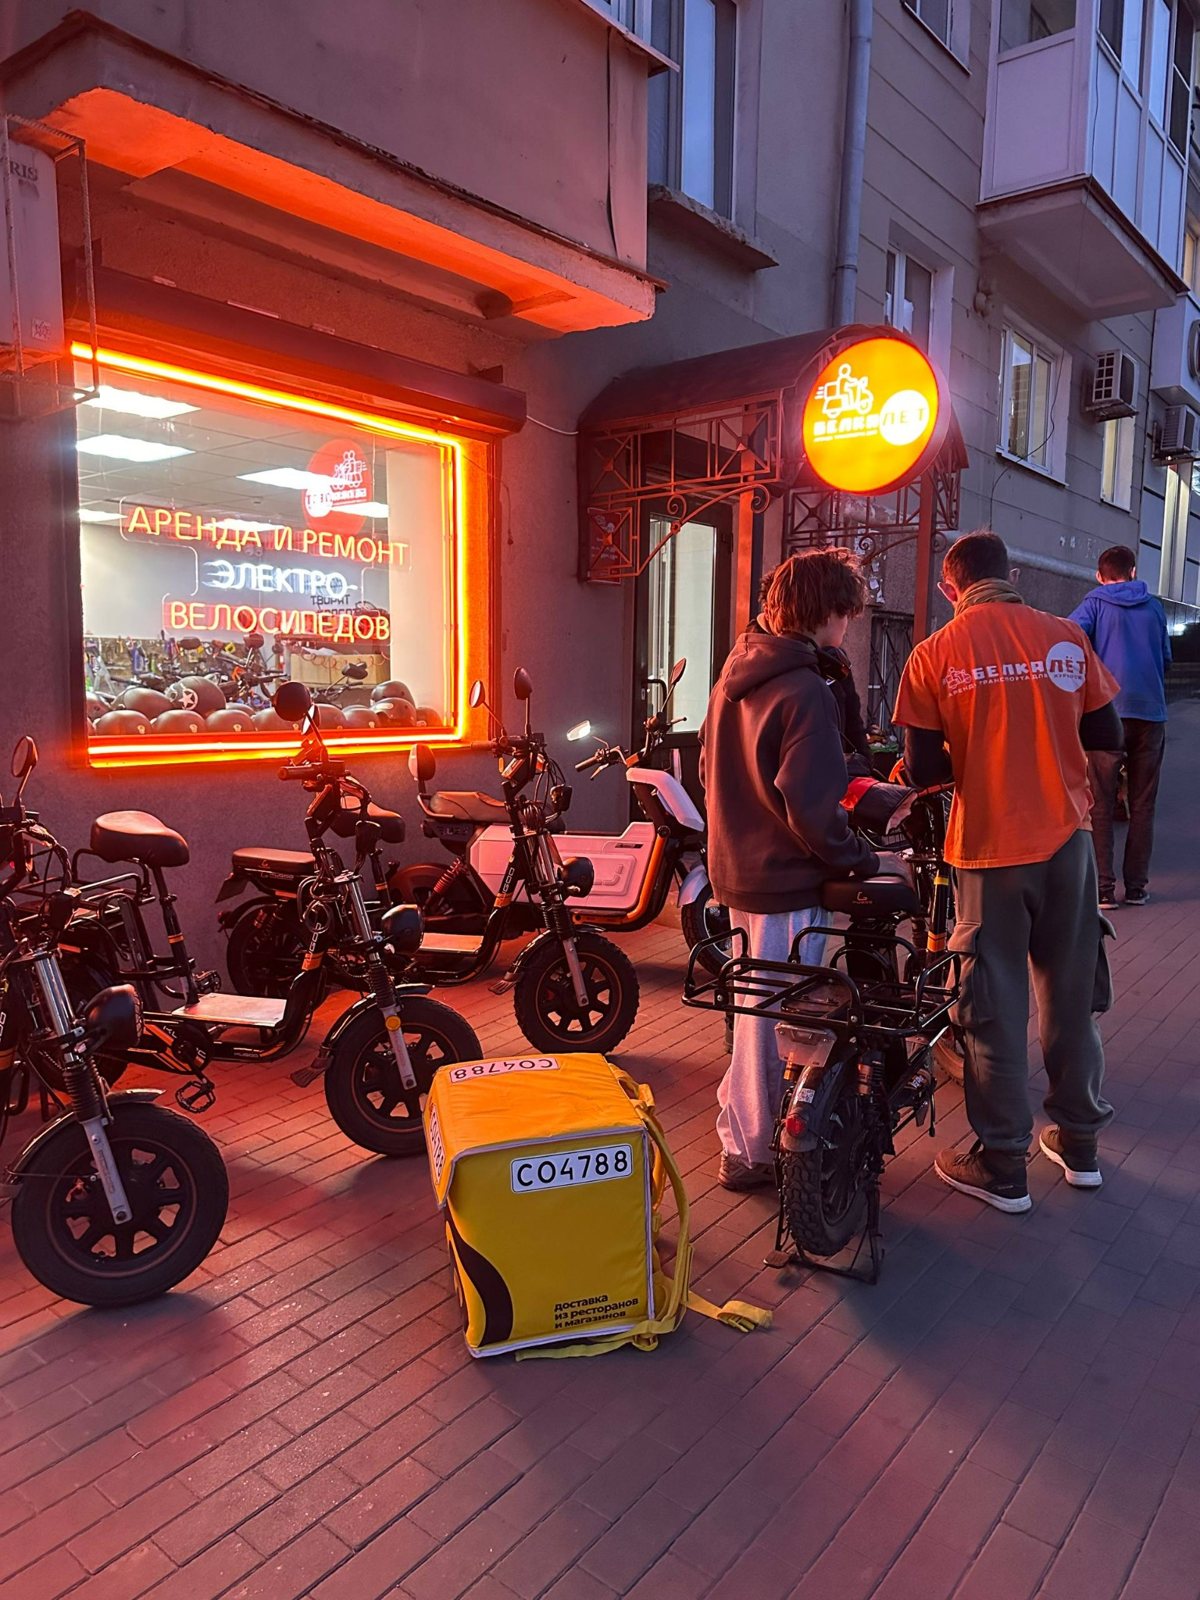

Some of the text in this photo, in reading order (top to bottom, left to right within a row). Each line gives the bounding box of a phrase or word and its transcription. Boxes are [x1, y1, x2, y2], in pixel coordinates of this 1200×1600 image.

[128, 507, 408, 566] АРЕНДА И РЕМОНТ
[170, 601, 390, 643] ВЕЛОСИПЕДОВ
[948, 683, 977, 697] АРЕНД
[554, 1294, 608, 1312] доставка
[554, 1298, 639, 1320] из ресторанов
[564, 1311, 626, 1327] магазинов
